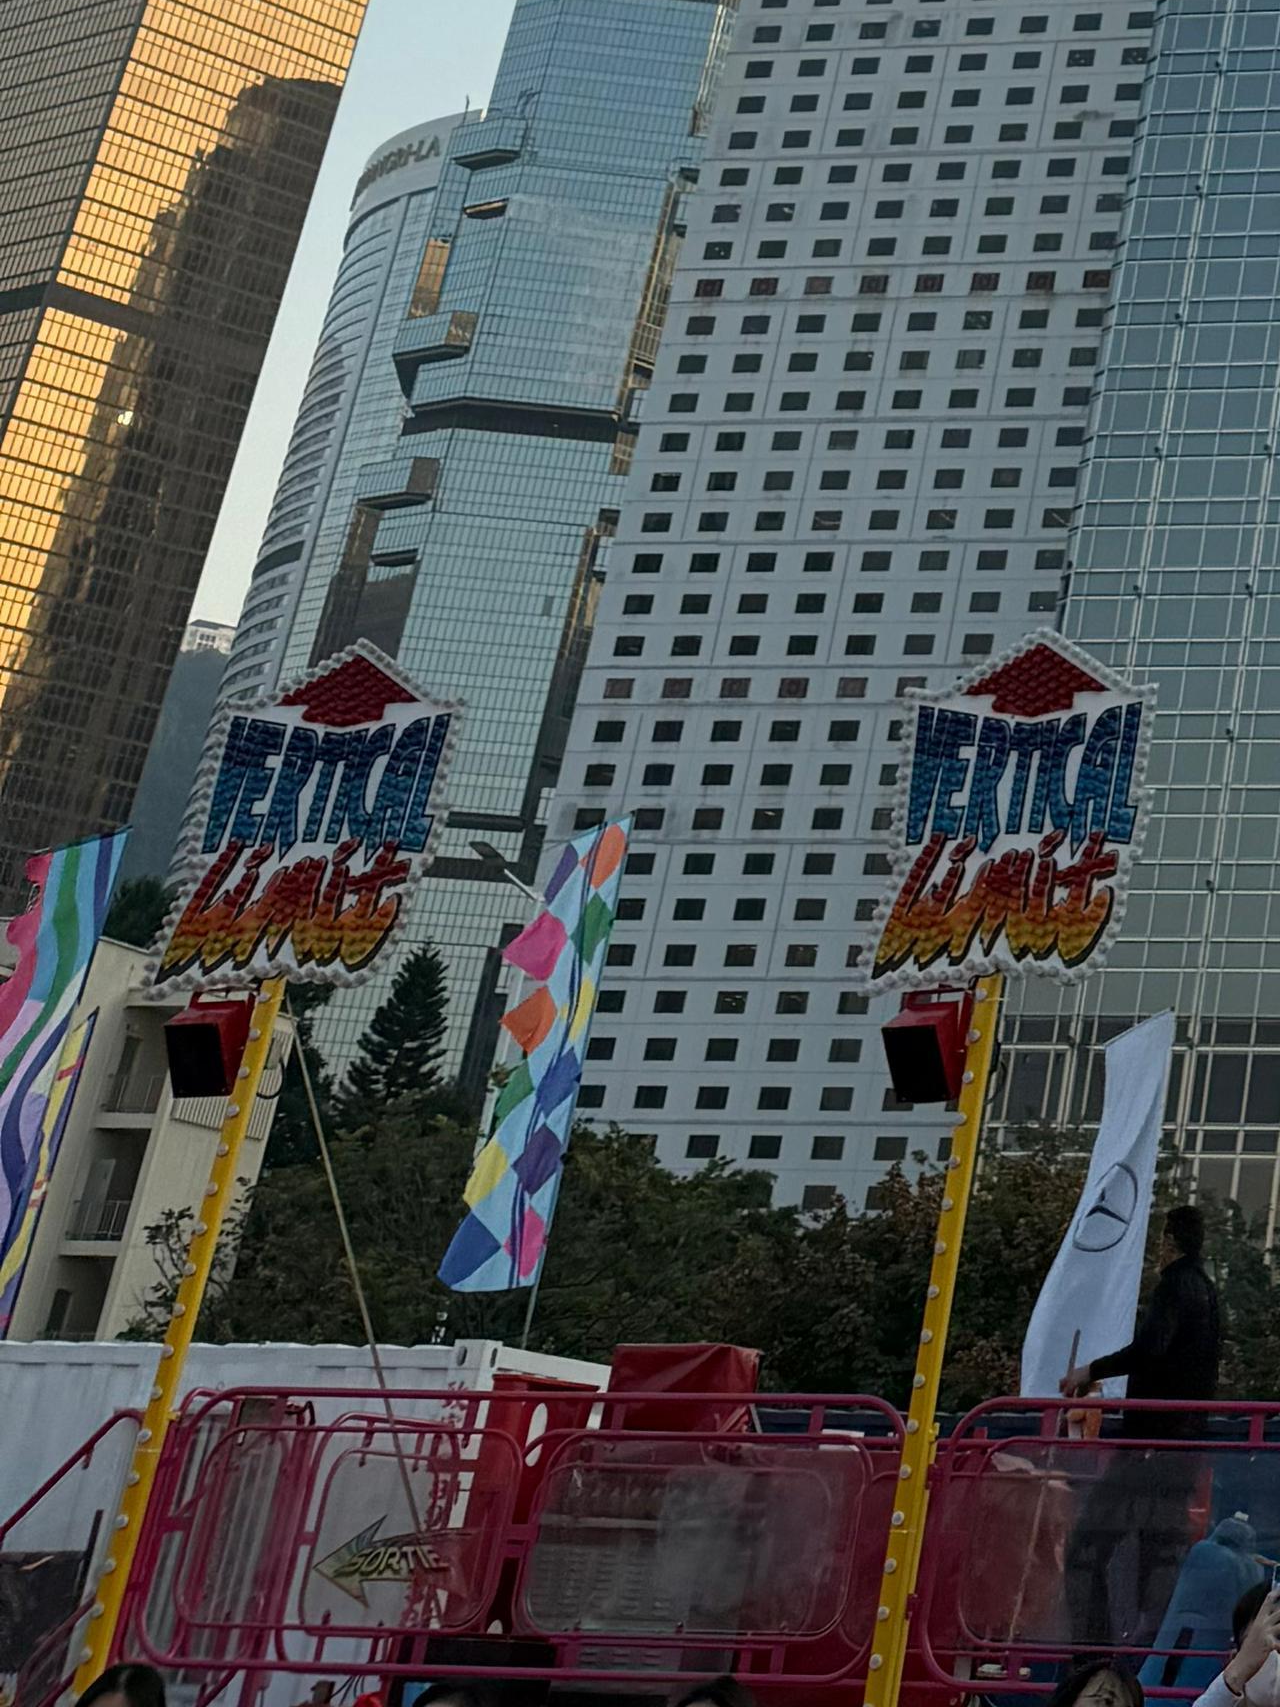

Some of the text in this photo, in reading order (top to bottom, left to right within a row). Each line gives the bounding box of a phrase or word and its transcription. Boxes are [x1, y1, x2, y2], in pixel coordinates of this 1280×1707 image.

[201, 713, 452, 866] VERTICAL
[906, 701, 1143, 858] VERTICAL
[154, 837, 411, 984] Limit
[872, 829, 1119, 979] Limit
[335, 1544, 449, 1578] SORTIE
